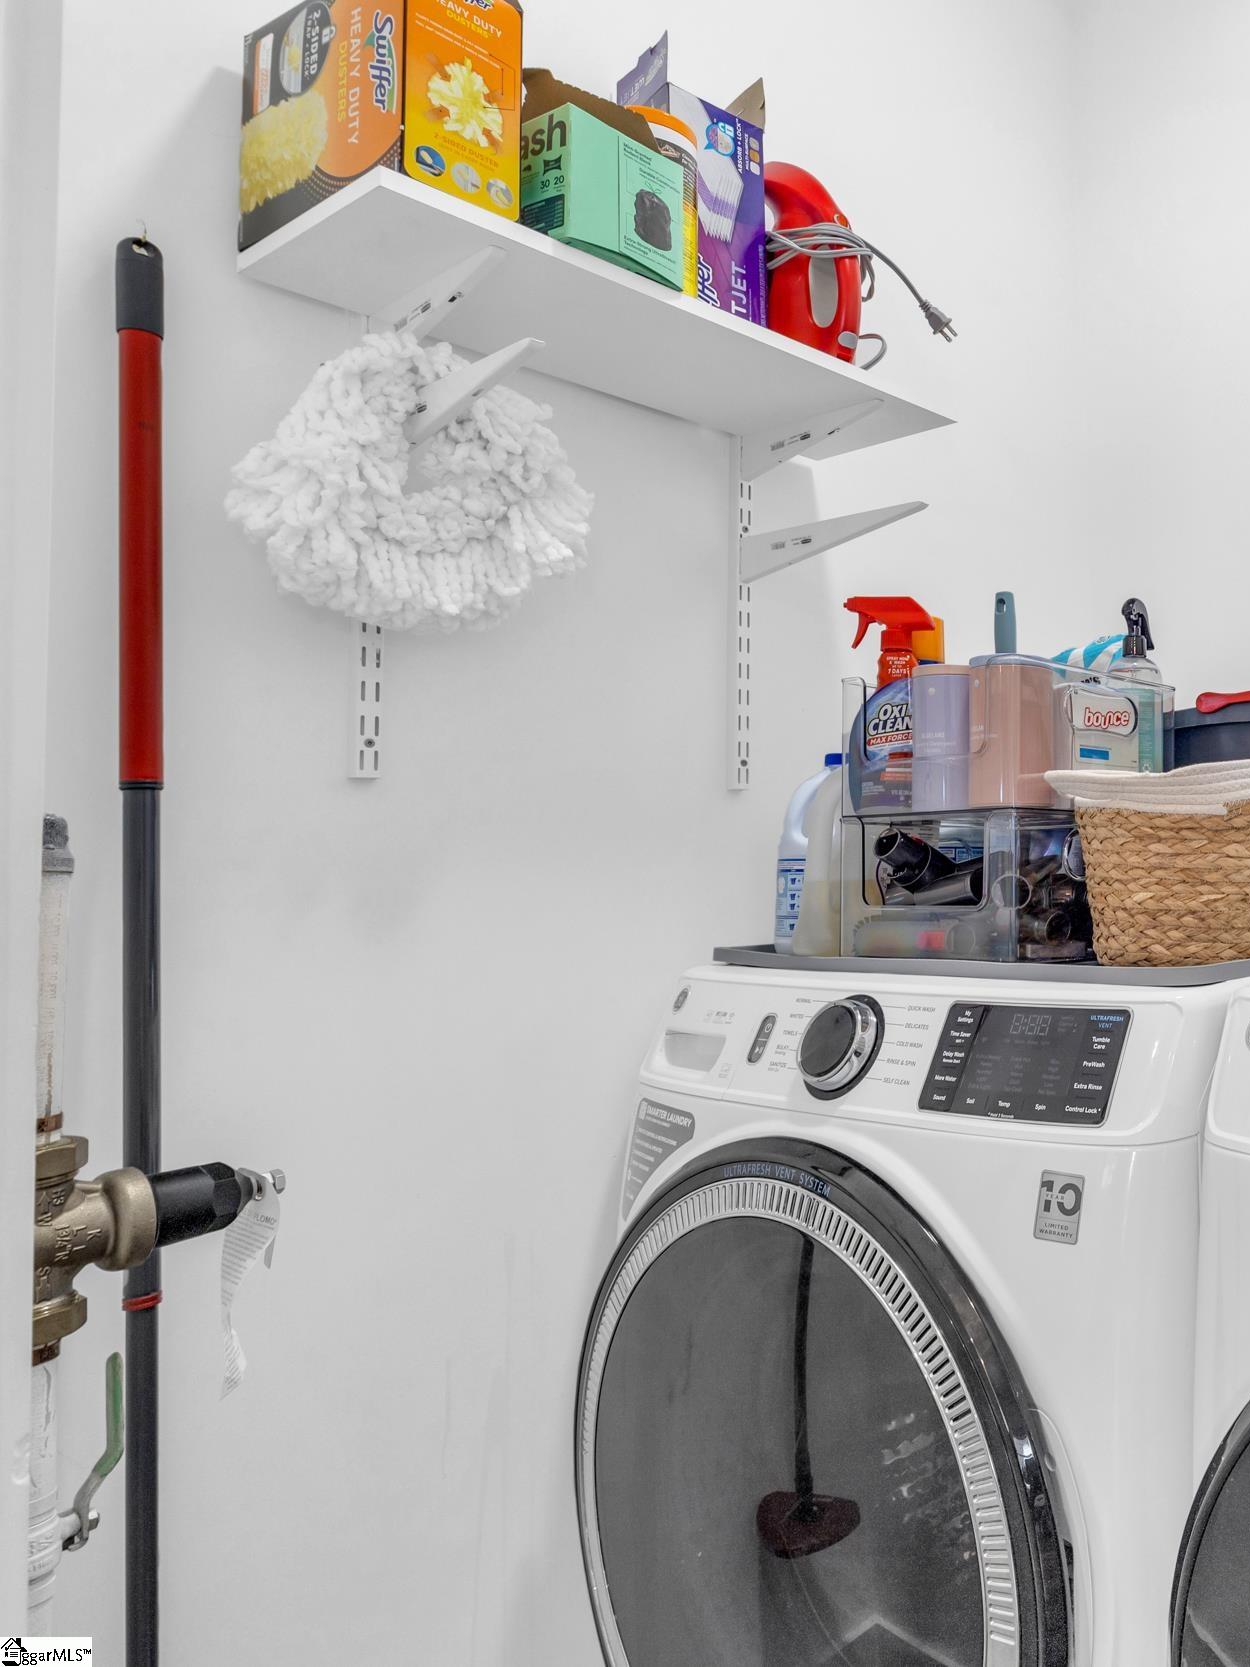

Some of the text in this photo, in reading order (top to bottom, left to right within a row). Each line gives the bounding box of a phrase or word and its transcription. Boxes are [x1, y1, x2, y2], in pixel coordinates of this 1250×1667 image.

[436, 0, 502, 38] EAVY DUTY
[310, 9, 321, 75] 2-SIDED
[368, 9, 395, 113] Swiffer
[337, 41, 347, 122] DUSTERS
[348, 7, 362, 144] HEAVY DUTY
[520, 114, 567, 160] ash
[540, 179, 550, 190] 30
[553, 175, 564, 185] 20
[731, 260, 747, 313] TJET
[878, 703, 908, 720] OXI
[1084, 707, 1131, 729] bounce
[867, 716, 912, 736] CLEAN
[870, 735, 887, 745] MAX
[887, 733, 912, 742] FORCE
[1082, 1060, 1105, 1068] PreWash
[998, 1100, 1010, 1108] Temp
[1034, 1103, 1046, 1111] Spin
[1065, 1105, 1097, 1114] Control Lock
[723, 1163, 832, 1197] ULTRAFRESH VENT SYSTEM
[1041, 1180, 1082, 1216] 10
[1040, 1229, 1073, 1239] WARRANTY
[1043, 1223, 1069, 1231] LIMITED
